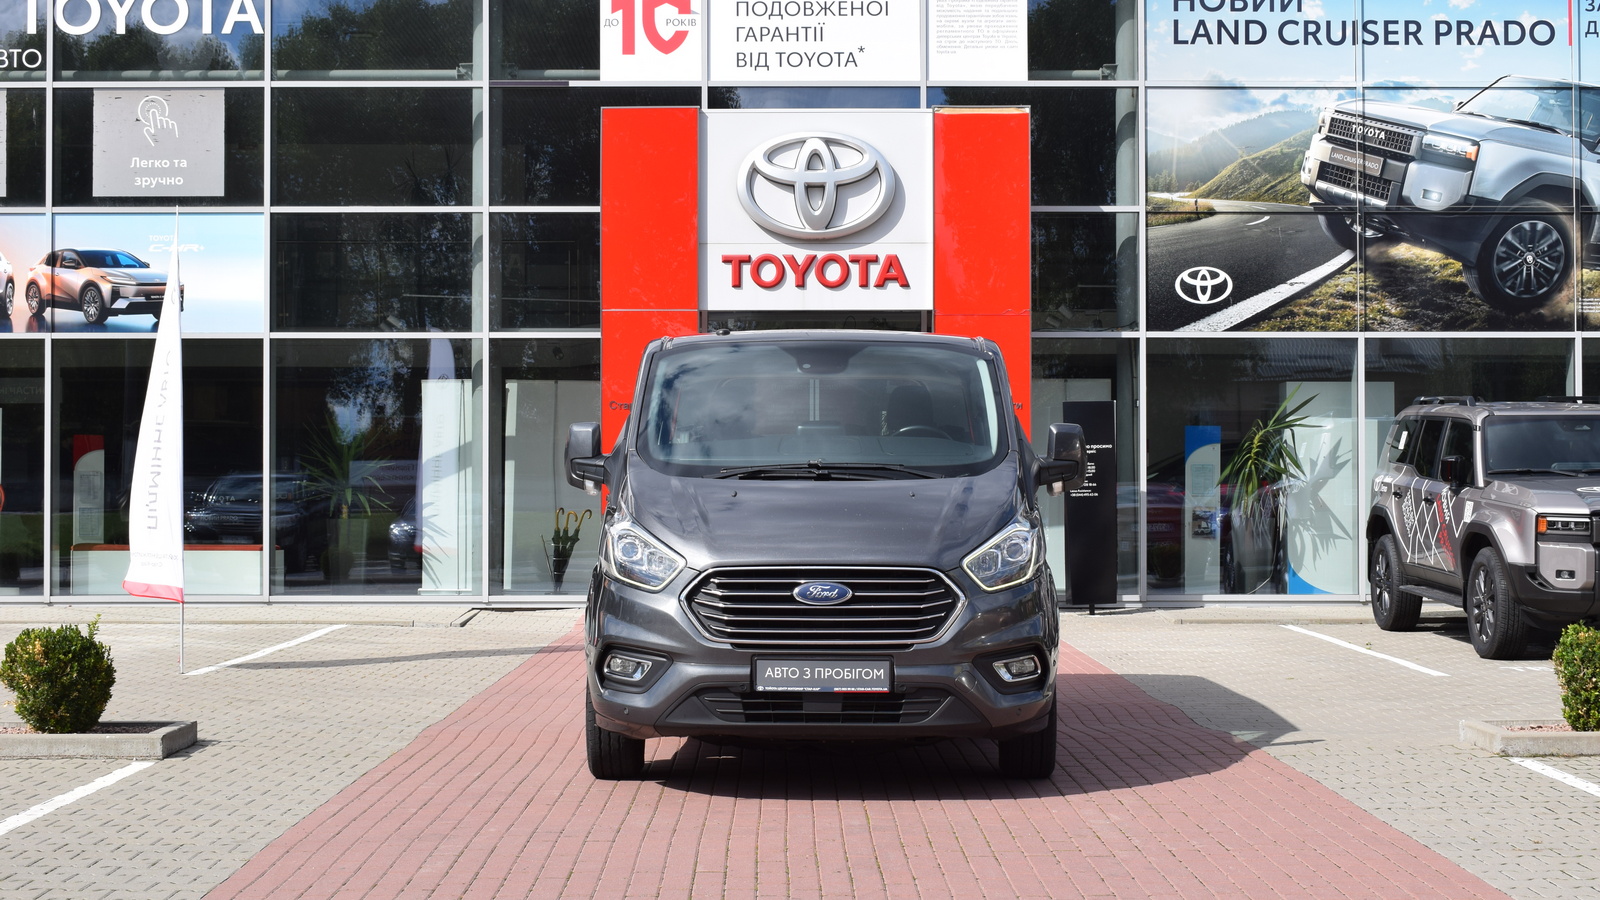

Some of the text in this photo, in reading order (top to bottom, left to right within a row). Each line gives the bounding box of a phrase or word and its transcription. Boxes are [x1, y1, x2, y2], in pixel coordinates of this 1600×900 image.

[1584, 0, 1600, 12] З
[26, 0, 265, 35] TOYOTA
[604, 18, 620, 28] ДО
[665, 18, 697, 27] РОКІВ
[736, 22, 826, 42] ГАРАНТІЇ
[1173, 19, 1556, 46] LAND CRUISER PRADO
[736, 52, 770, 71] ВІД
[1352, 124, 1385, 140] TOYOTA
[130, 157, 188, 168] Легко та
[1330, 152, 1343, 160] LAND
[134, 176, 184, 188] зручно
[721, 253, 911, 290] TOYOTA
[9, 386, 44, 394] ЧАСТИ
[806, 585, 838, 599] Ford
[764, 667, 884, 680] АВТО З ПРОБІГОМ
